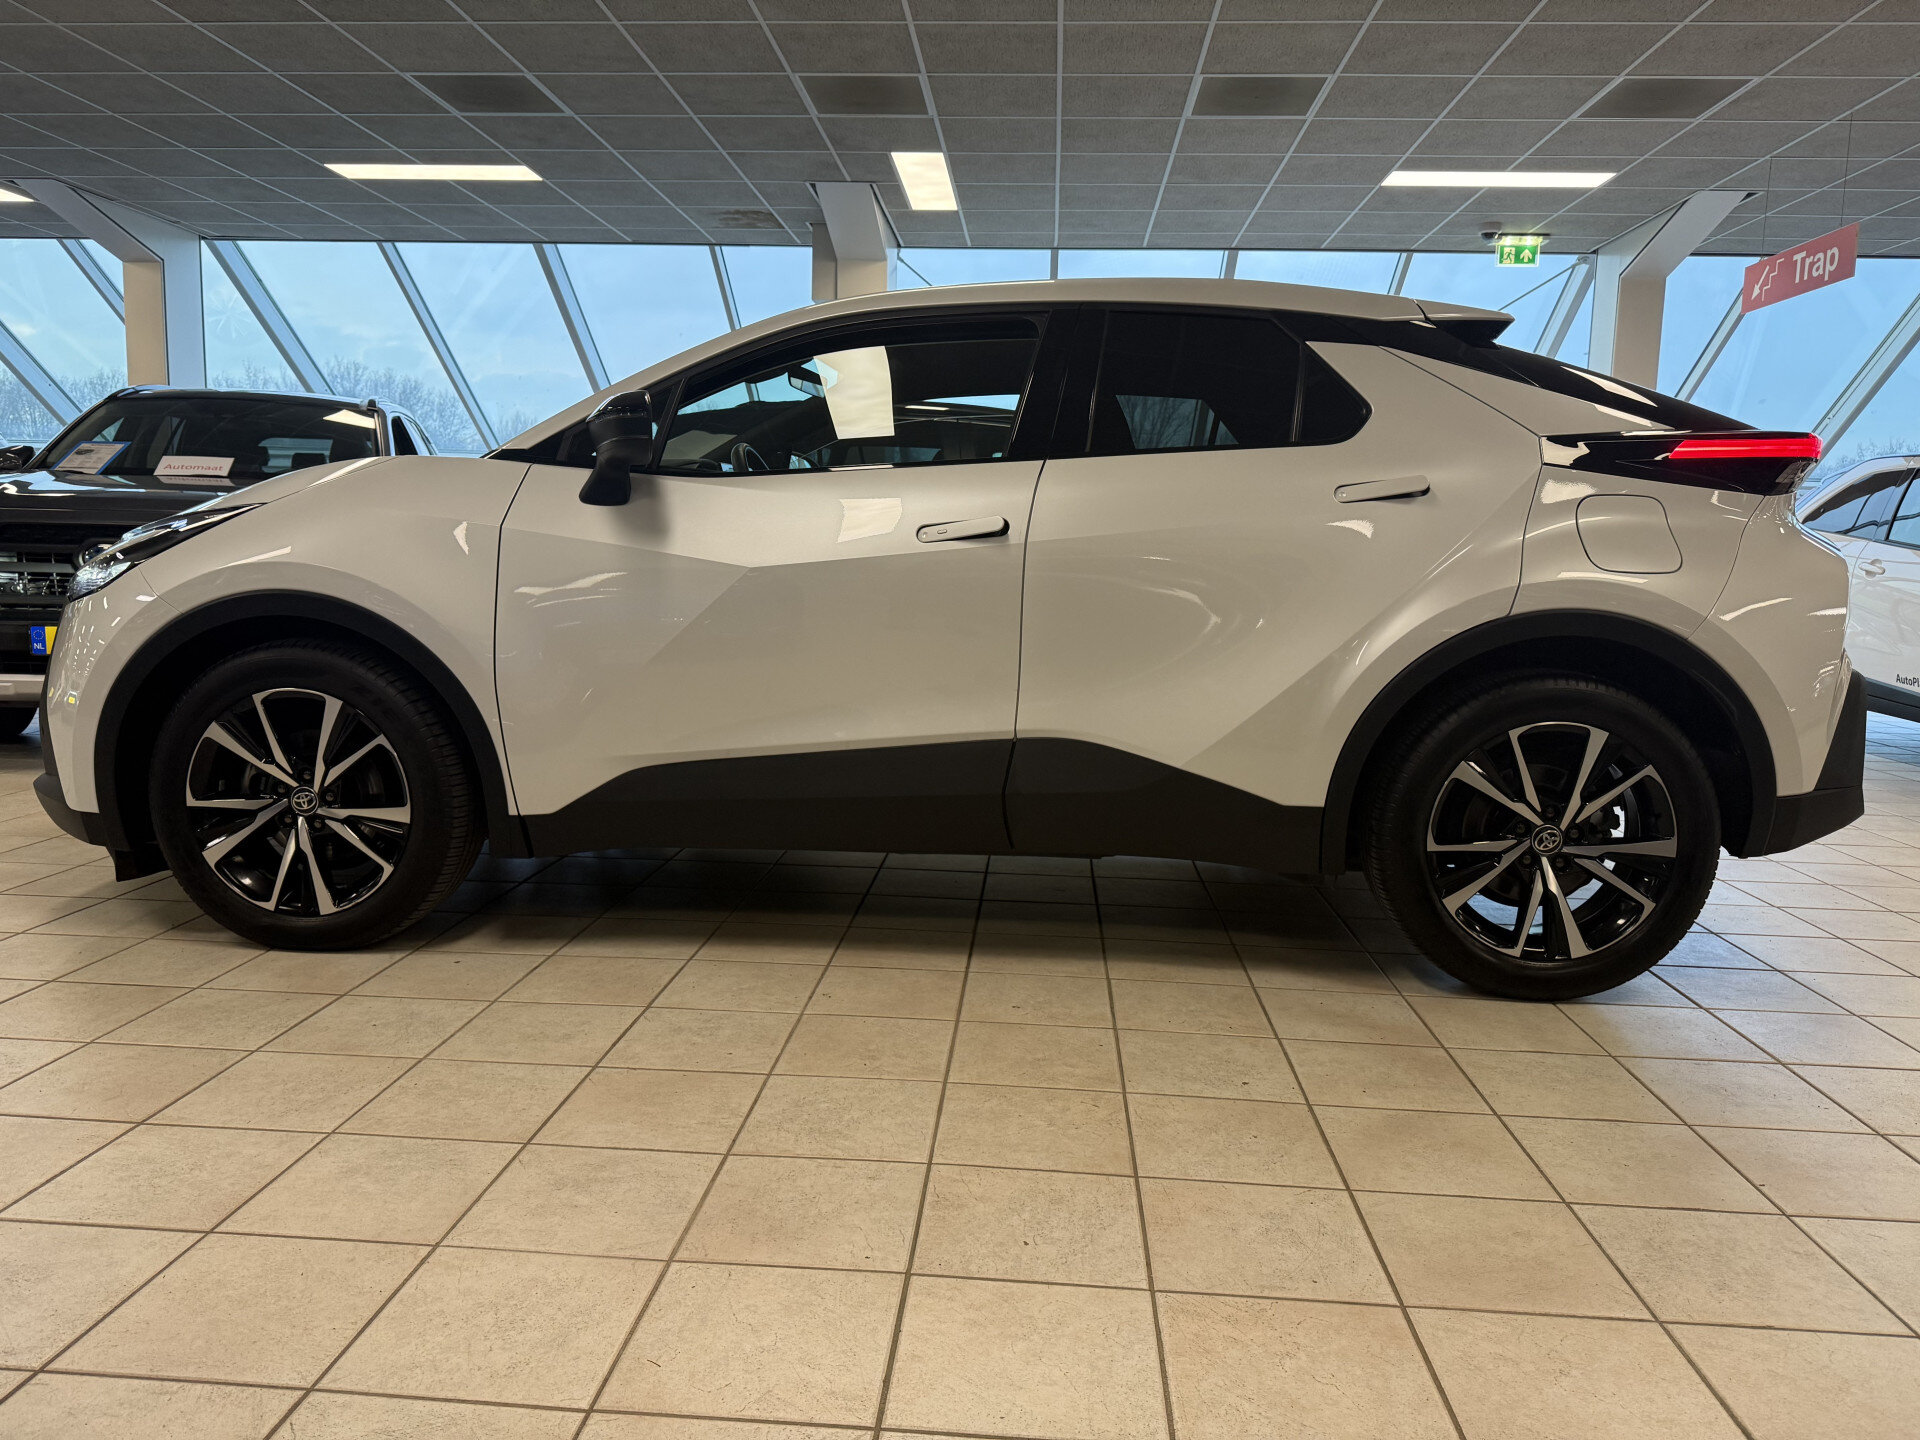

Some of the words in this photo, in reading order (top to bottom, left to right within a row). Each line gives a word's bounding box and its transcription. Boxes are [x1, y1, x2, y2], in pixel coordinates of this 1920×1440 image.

[1792, 246, 1840, 284] Trap
[163, 463, 223, 472] Automaat
[33, 642, 45, 650] NL
